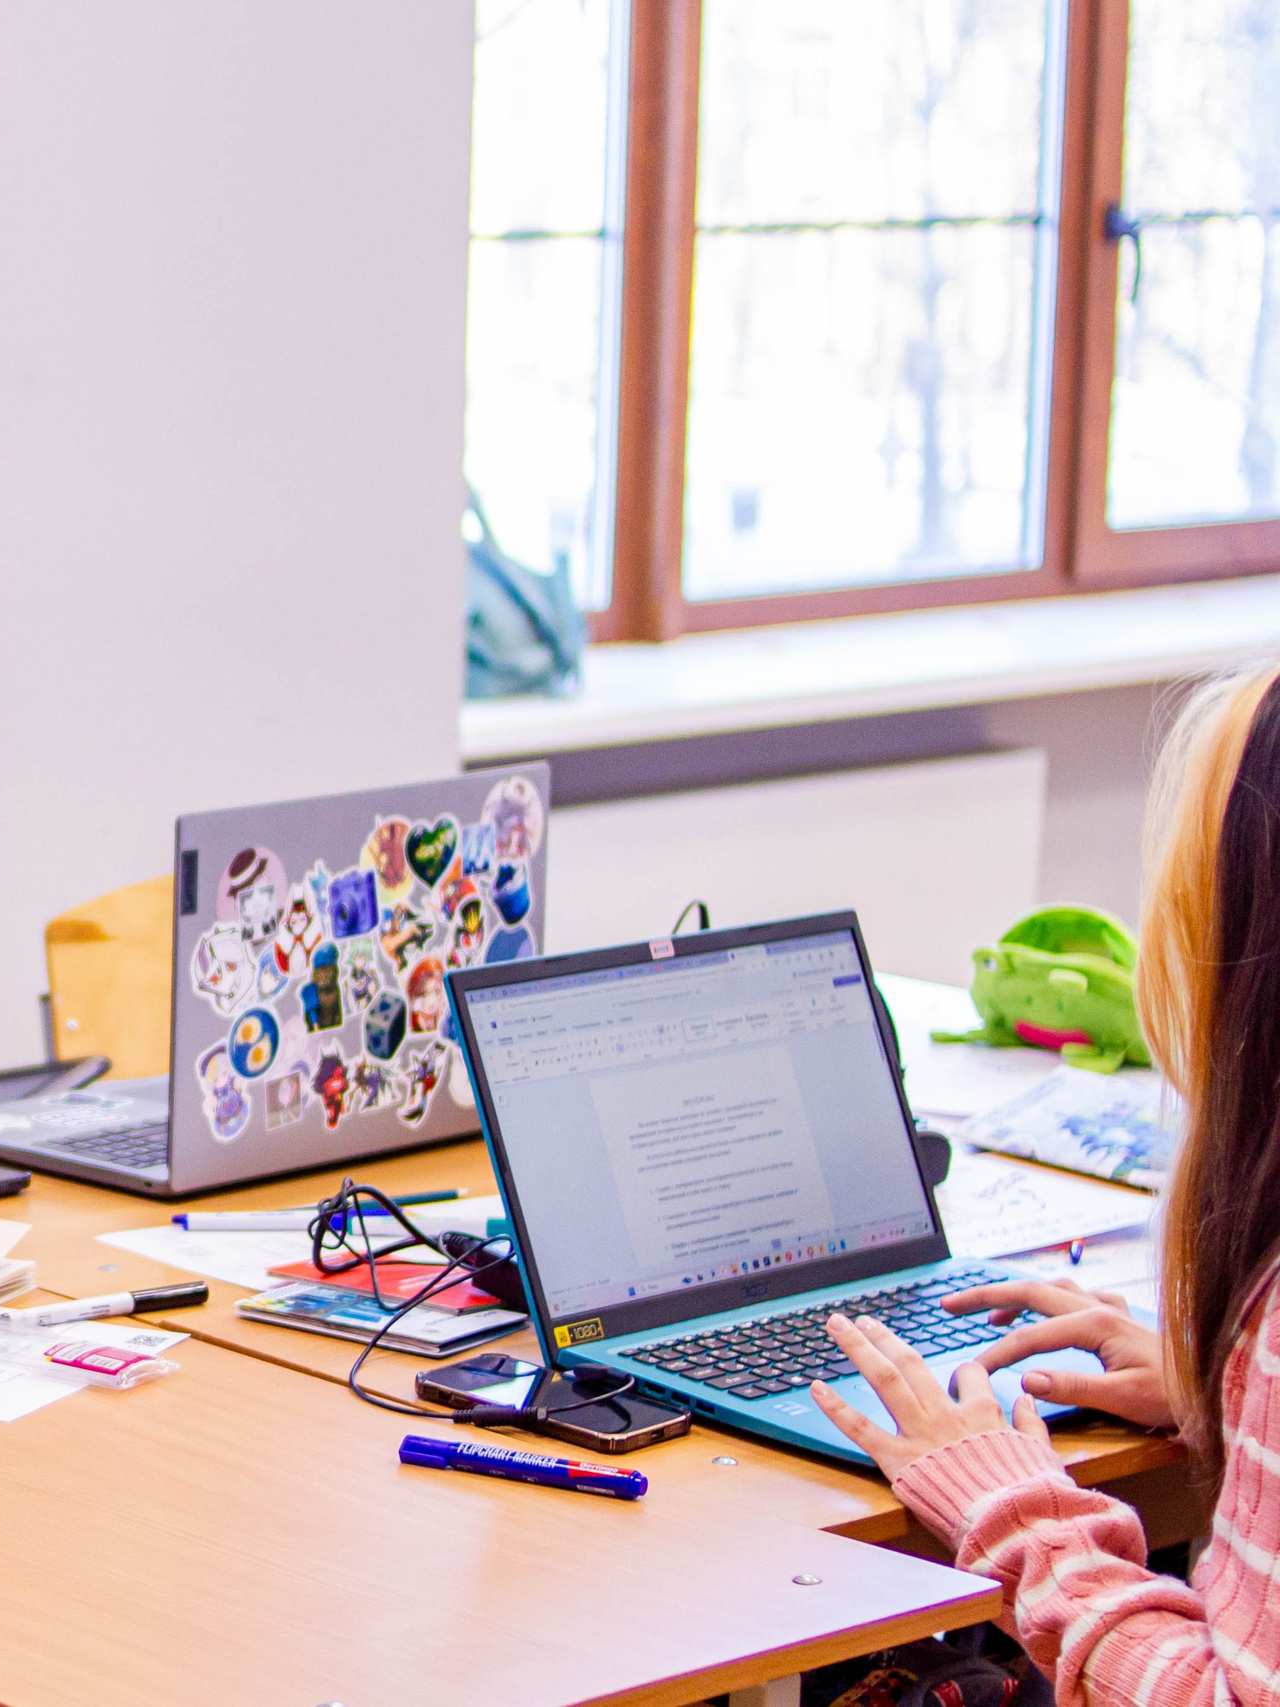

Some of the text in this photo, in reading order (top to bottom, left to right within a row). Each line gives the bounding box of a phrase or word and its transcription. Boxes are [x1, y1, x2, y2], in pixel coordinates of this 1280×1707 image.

[573, 1324, 597, 1340] 1080
[457, 1442, 558, 1468] FLIPCHART MARKER
